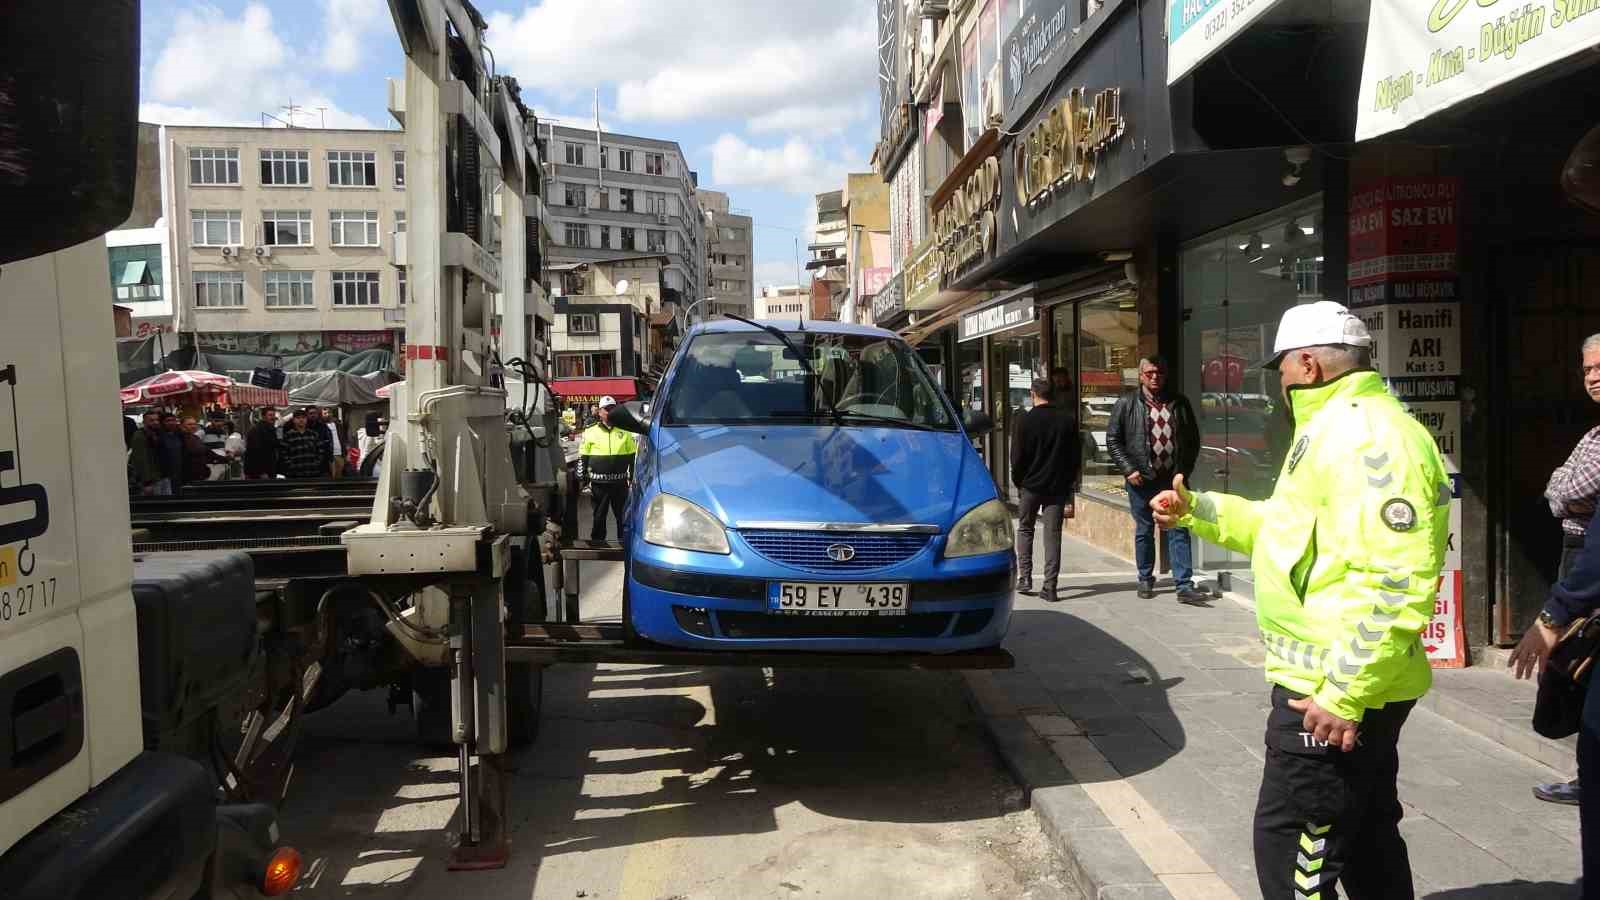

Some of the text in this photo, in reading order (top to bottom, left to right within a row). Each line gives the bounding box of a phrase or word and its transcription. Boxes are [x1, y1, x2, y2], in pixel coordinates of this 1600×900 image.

[1375, 70, 1415, 114] Nişan
[1426, 46, 1465, 88] Kına
[1479, 3, 1546, 62] Düğün
[1391, 202, 1454, 226] SAZ EVİ
[1398, 309, 1454, 329] Hanifi
[1409, 337, 1442, 358] ARI
[1406, 361, 1427, 373] Kat
[1438, 361, 1445, 372] 3
[0, 577, 56, 621] 8 27 17
[781, 585, 904, 609] 59 EY 439
